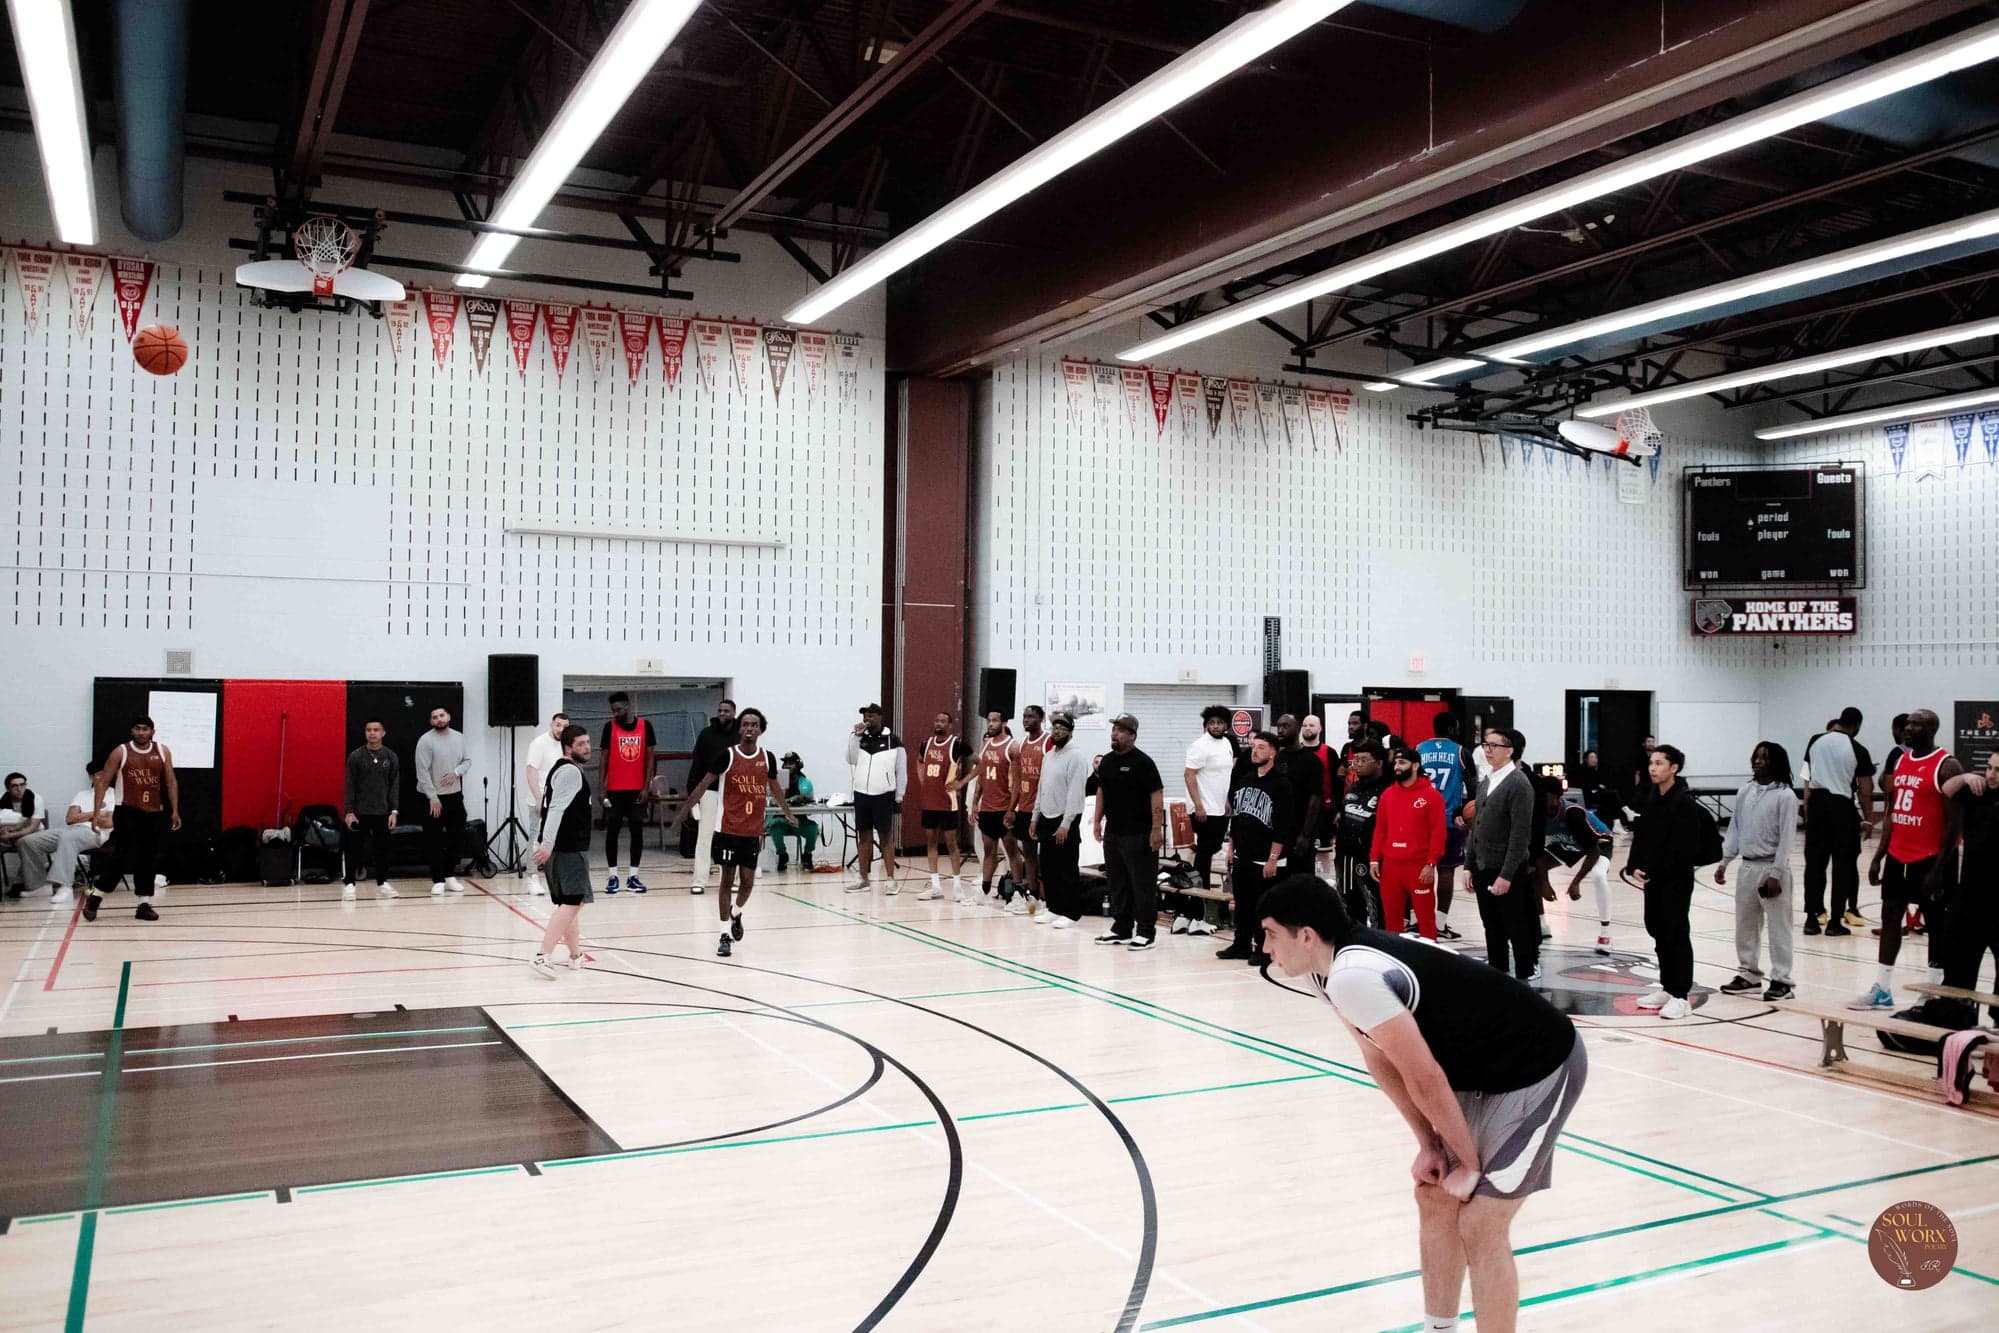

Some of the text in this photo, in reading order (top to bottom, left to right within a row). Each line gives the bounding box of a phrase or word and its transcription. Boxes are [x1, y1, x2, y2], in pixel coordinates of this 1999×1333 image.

[1694, 476, 1731, 487] Panthers
[1817, 473, 1852, 484] Guests
[1758, 512, 1789, 524] period
[1698, 532, 1720, 542] fouls
[1758, 530, 1789, 541] player
[1827, 528, 1851, 539] fouls
[1700, 570, 1719, 579] won
[1761, 570, 1786, 580] game
[1830, 569, 1849, 577] won
[1746, 601, 1839, 613] HOME OF THE
[1733, 613, 1853, 631] PANTHERS
[1421, 752, 1455, 766] HIGH HEAT
[128, 768, 151, 777] SOUL
[986, 766, 998, 780] 14
[732, 776, 757, 785] SOUL
[1424, 768, 1451, 791] 27
[739, 784, 766, 794] WORX
[143, 791, 150, 803] 6
[1894, 789, 1915, 812] 16
[746, 801, 753, 815] 0
